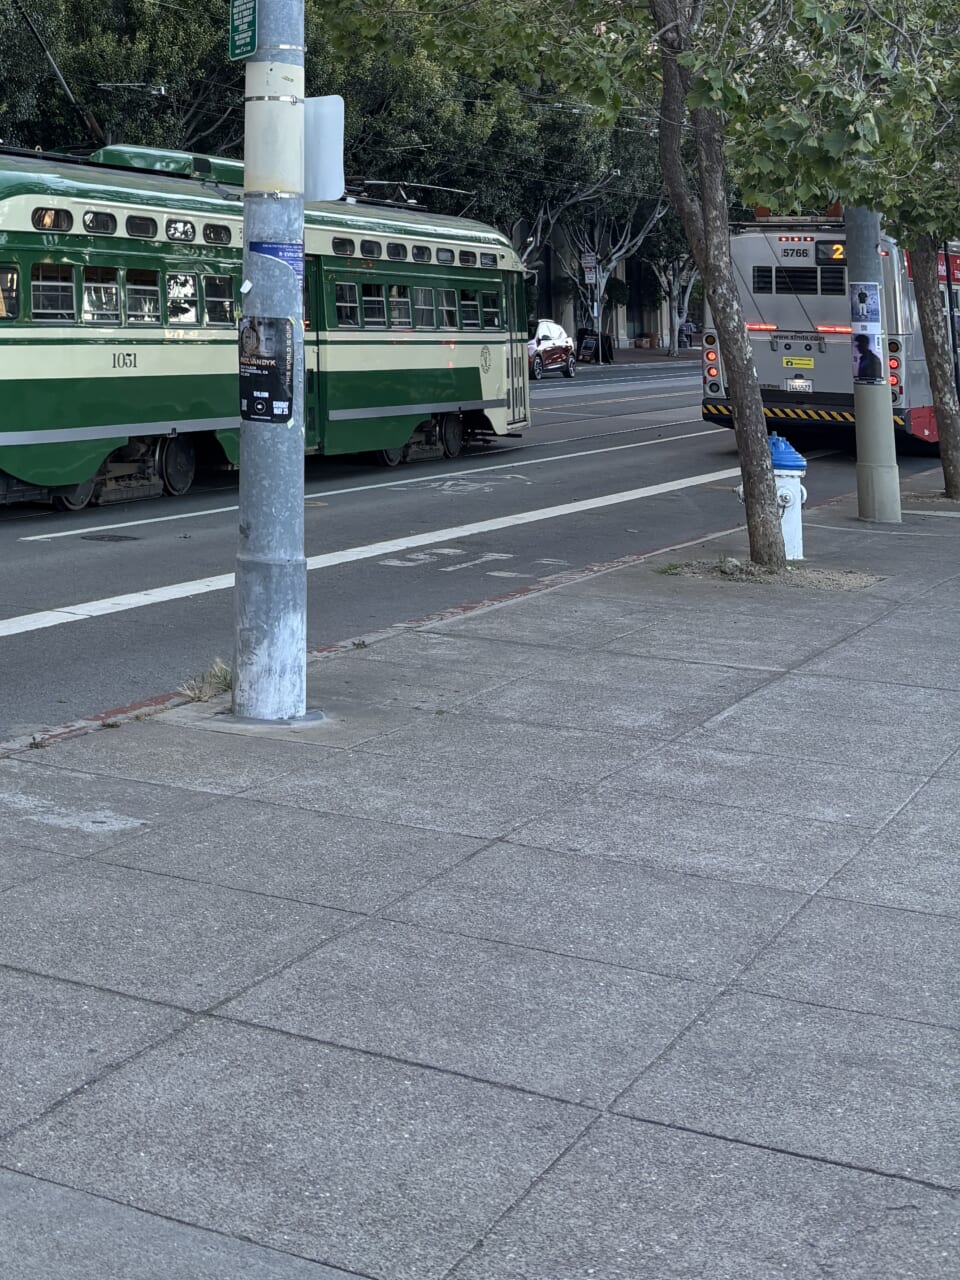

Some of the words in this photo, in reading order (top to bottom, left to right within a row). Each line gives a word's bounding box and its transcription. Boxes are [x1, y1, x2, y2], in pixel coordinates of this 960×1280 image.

[783, 248, 808, 257] 5766
[832, 244, 844, 259] 2
[112, 352, 138, 369] 1051
